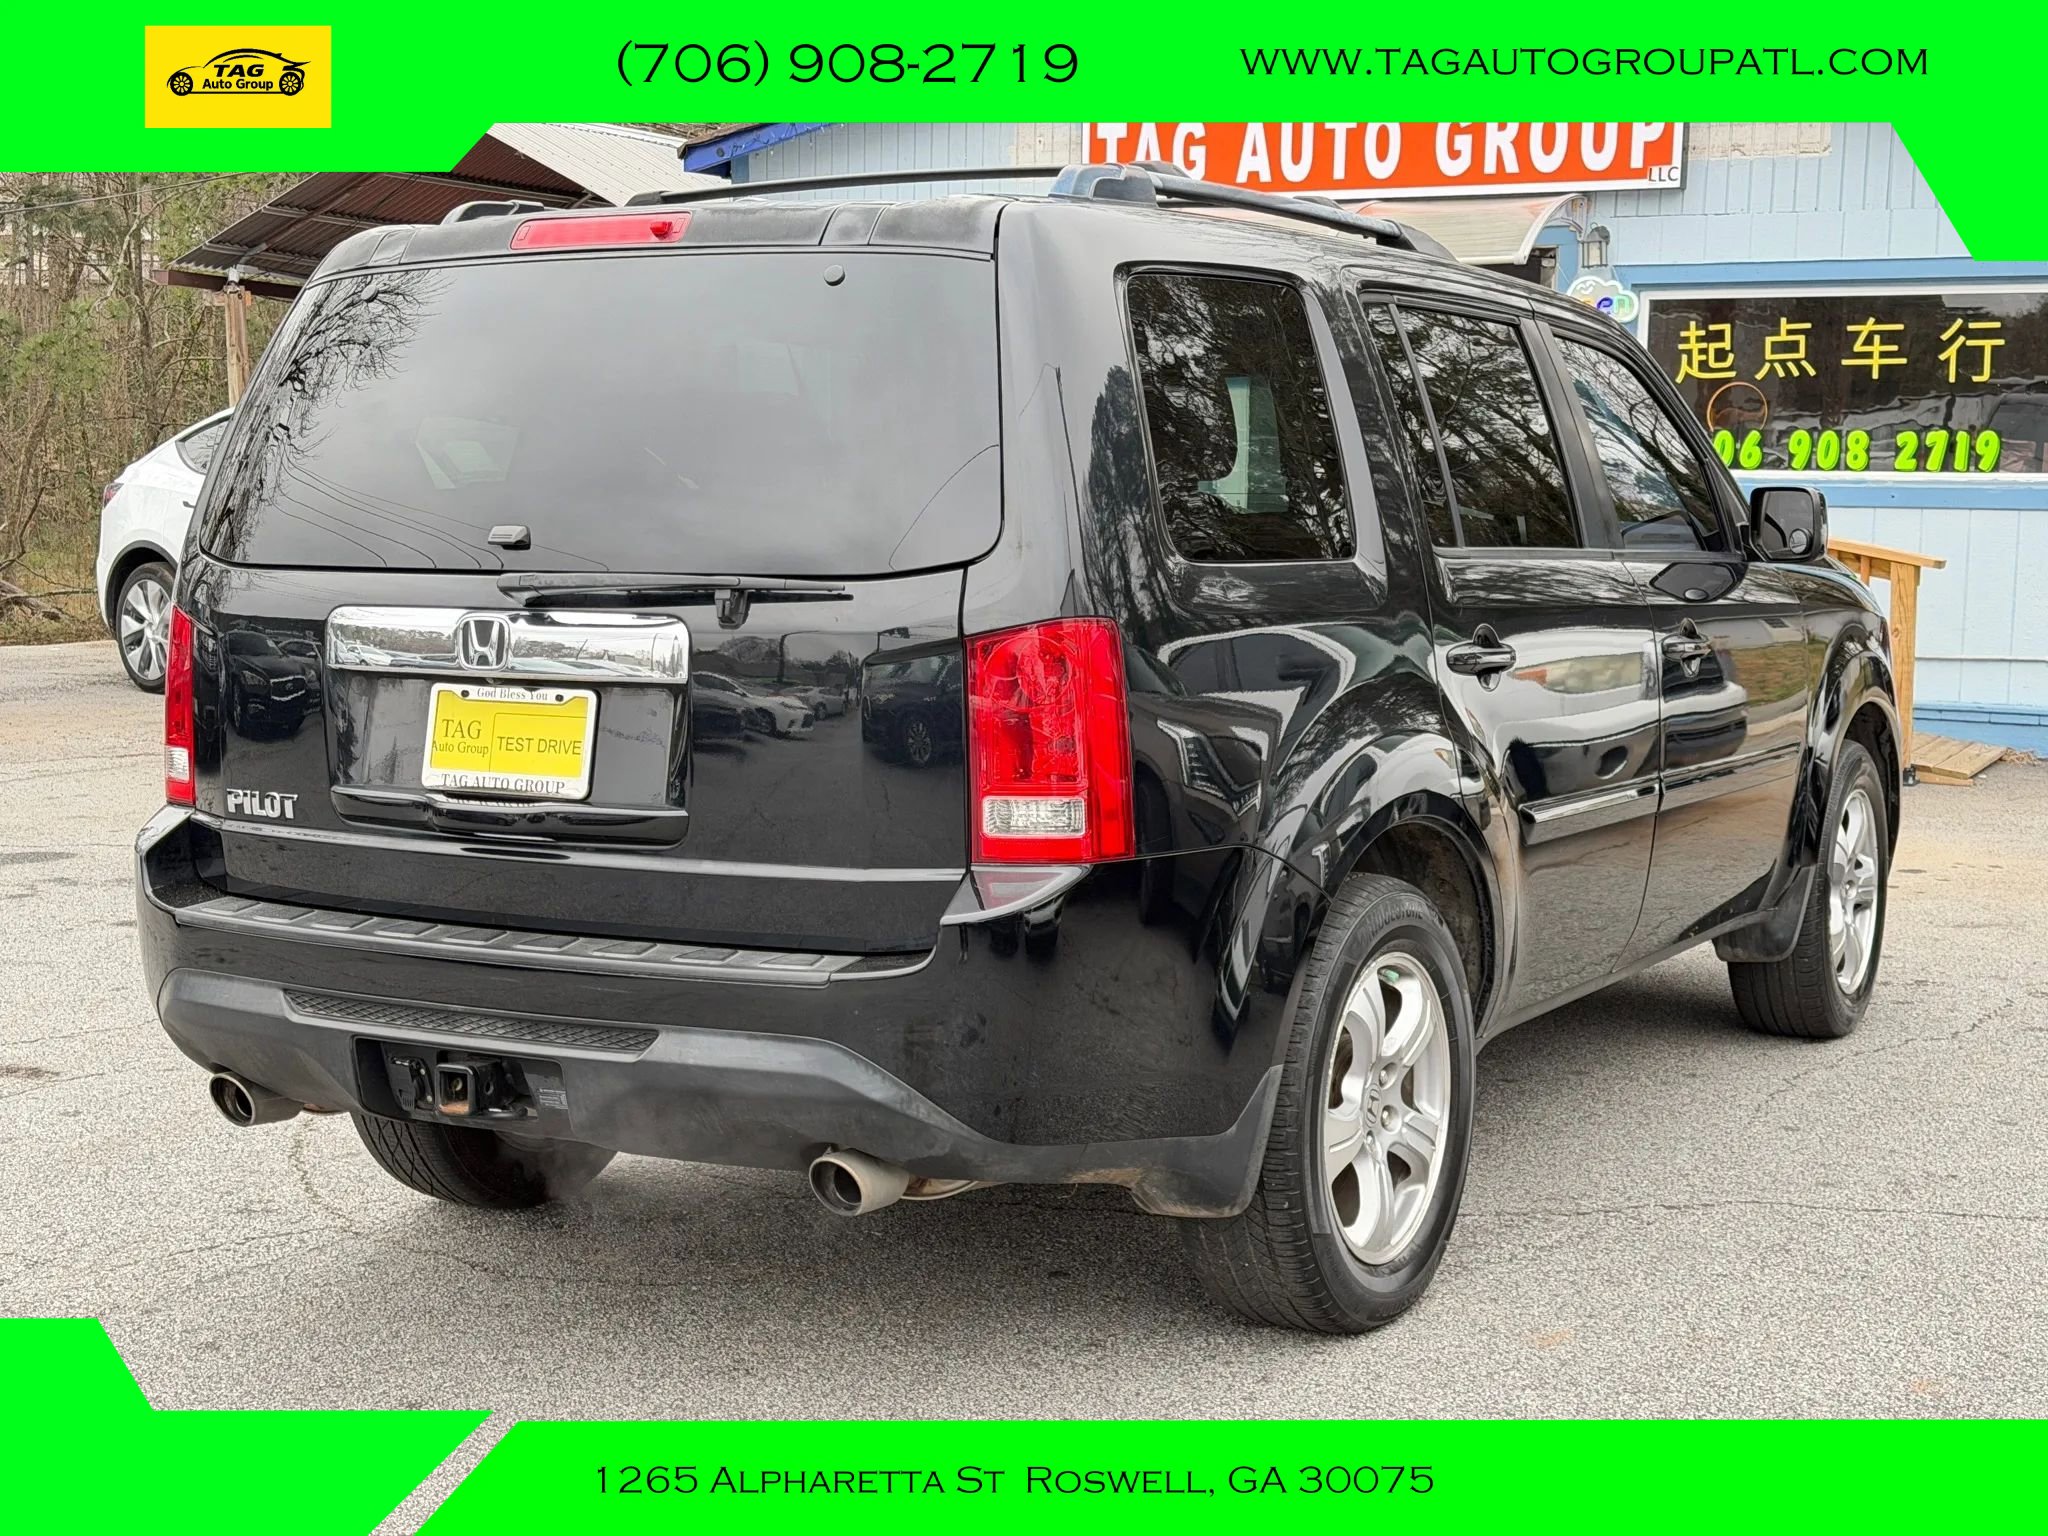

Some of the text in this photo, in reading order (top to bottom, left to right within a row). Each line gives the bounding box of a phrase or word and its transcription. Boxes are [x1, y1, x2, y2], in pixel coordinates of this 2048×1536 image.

[1097, 122, 1666, 184] TAG AUTO GROUP
[1648, 166, 1679, 182] LLC
[1675, 317, 2005, 384] 起点车行
[1713, 429, 2000, 473] 06 908 2719
[477, 687, 548, 701] God Bless You
[442, 719, 482, 739] TAG
[432, 740, 489, 758] Auto Group
[497, 736, 582, 755] TEST DRIVE
[441, 774, 565, 793] TAG AUTO GROUP
[226, 788, 298, 819] PILOT
